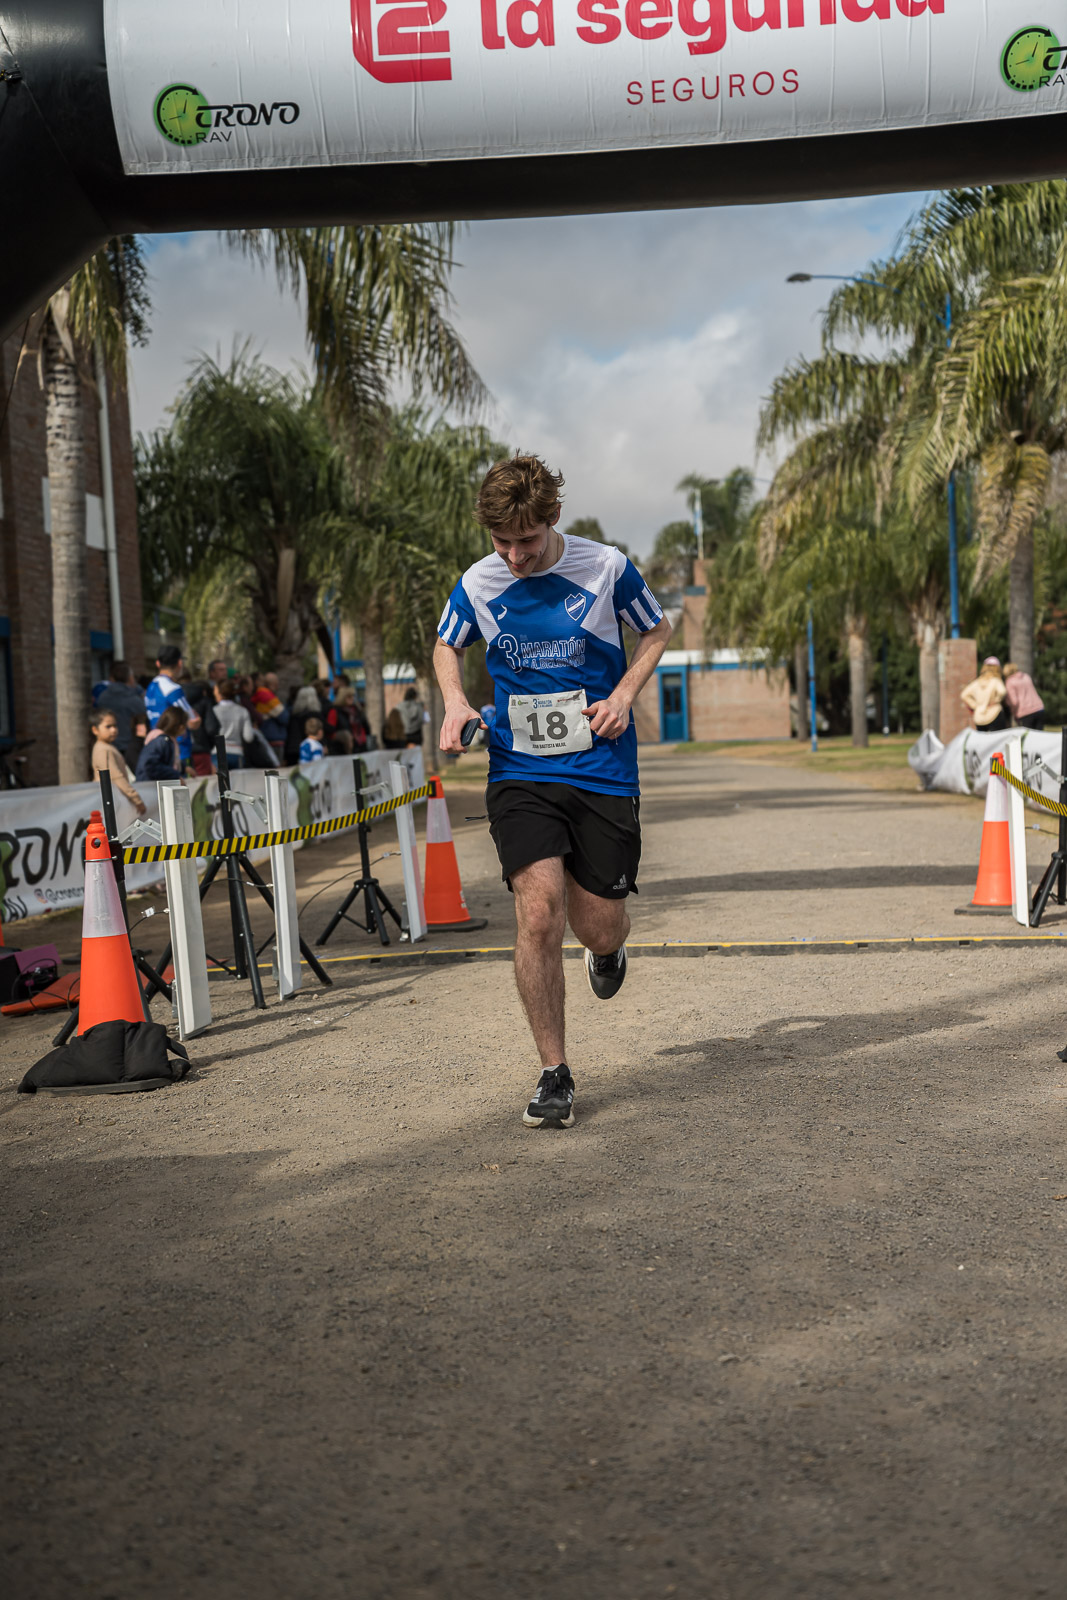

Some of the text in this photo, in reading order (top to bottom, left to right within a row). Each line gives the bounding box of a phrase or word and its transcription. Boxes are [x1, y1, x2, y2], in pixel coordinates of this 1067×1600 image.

[480, 0, 555, 50] la
[626, 68, 800, 106] SEGUROS
[1038, 74, 1067, 88] RA
[195, 102, 300, 128] CRONO
[195, 131, 232, 144] RAV
[497, 633, 586, 674] 3 MARATÓN
[526, 711, 569, 742] 18
[0, 817, 92, 887] RON
